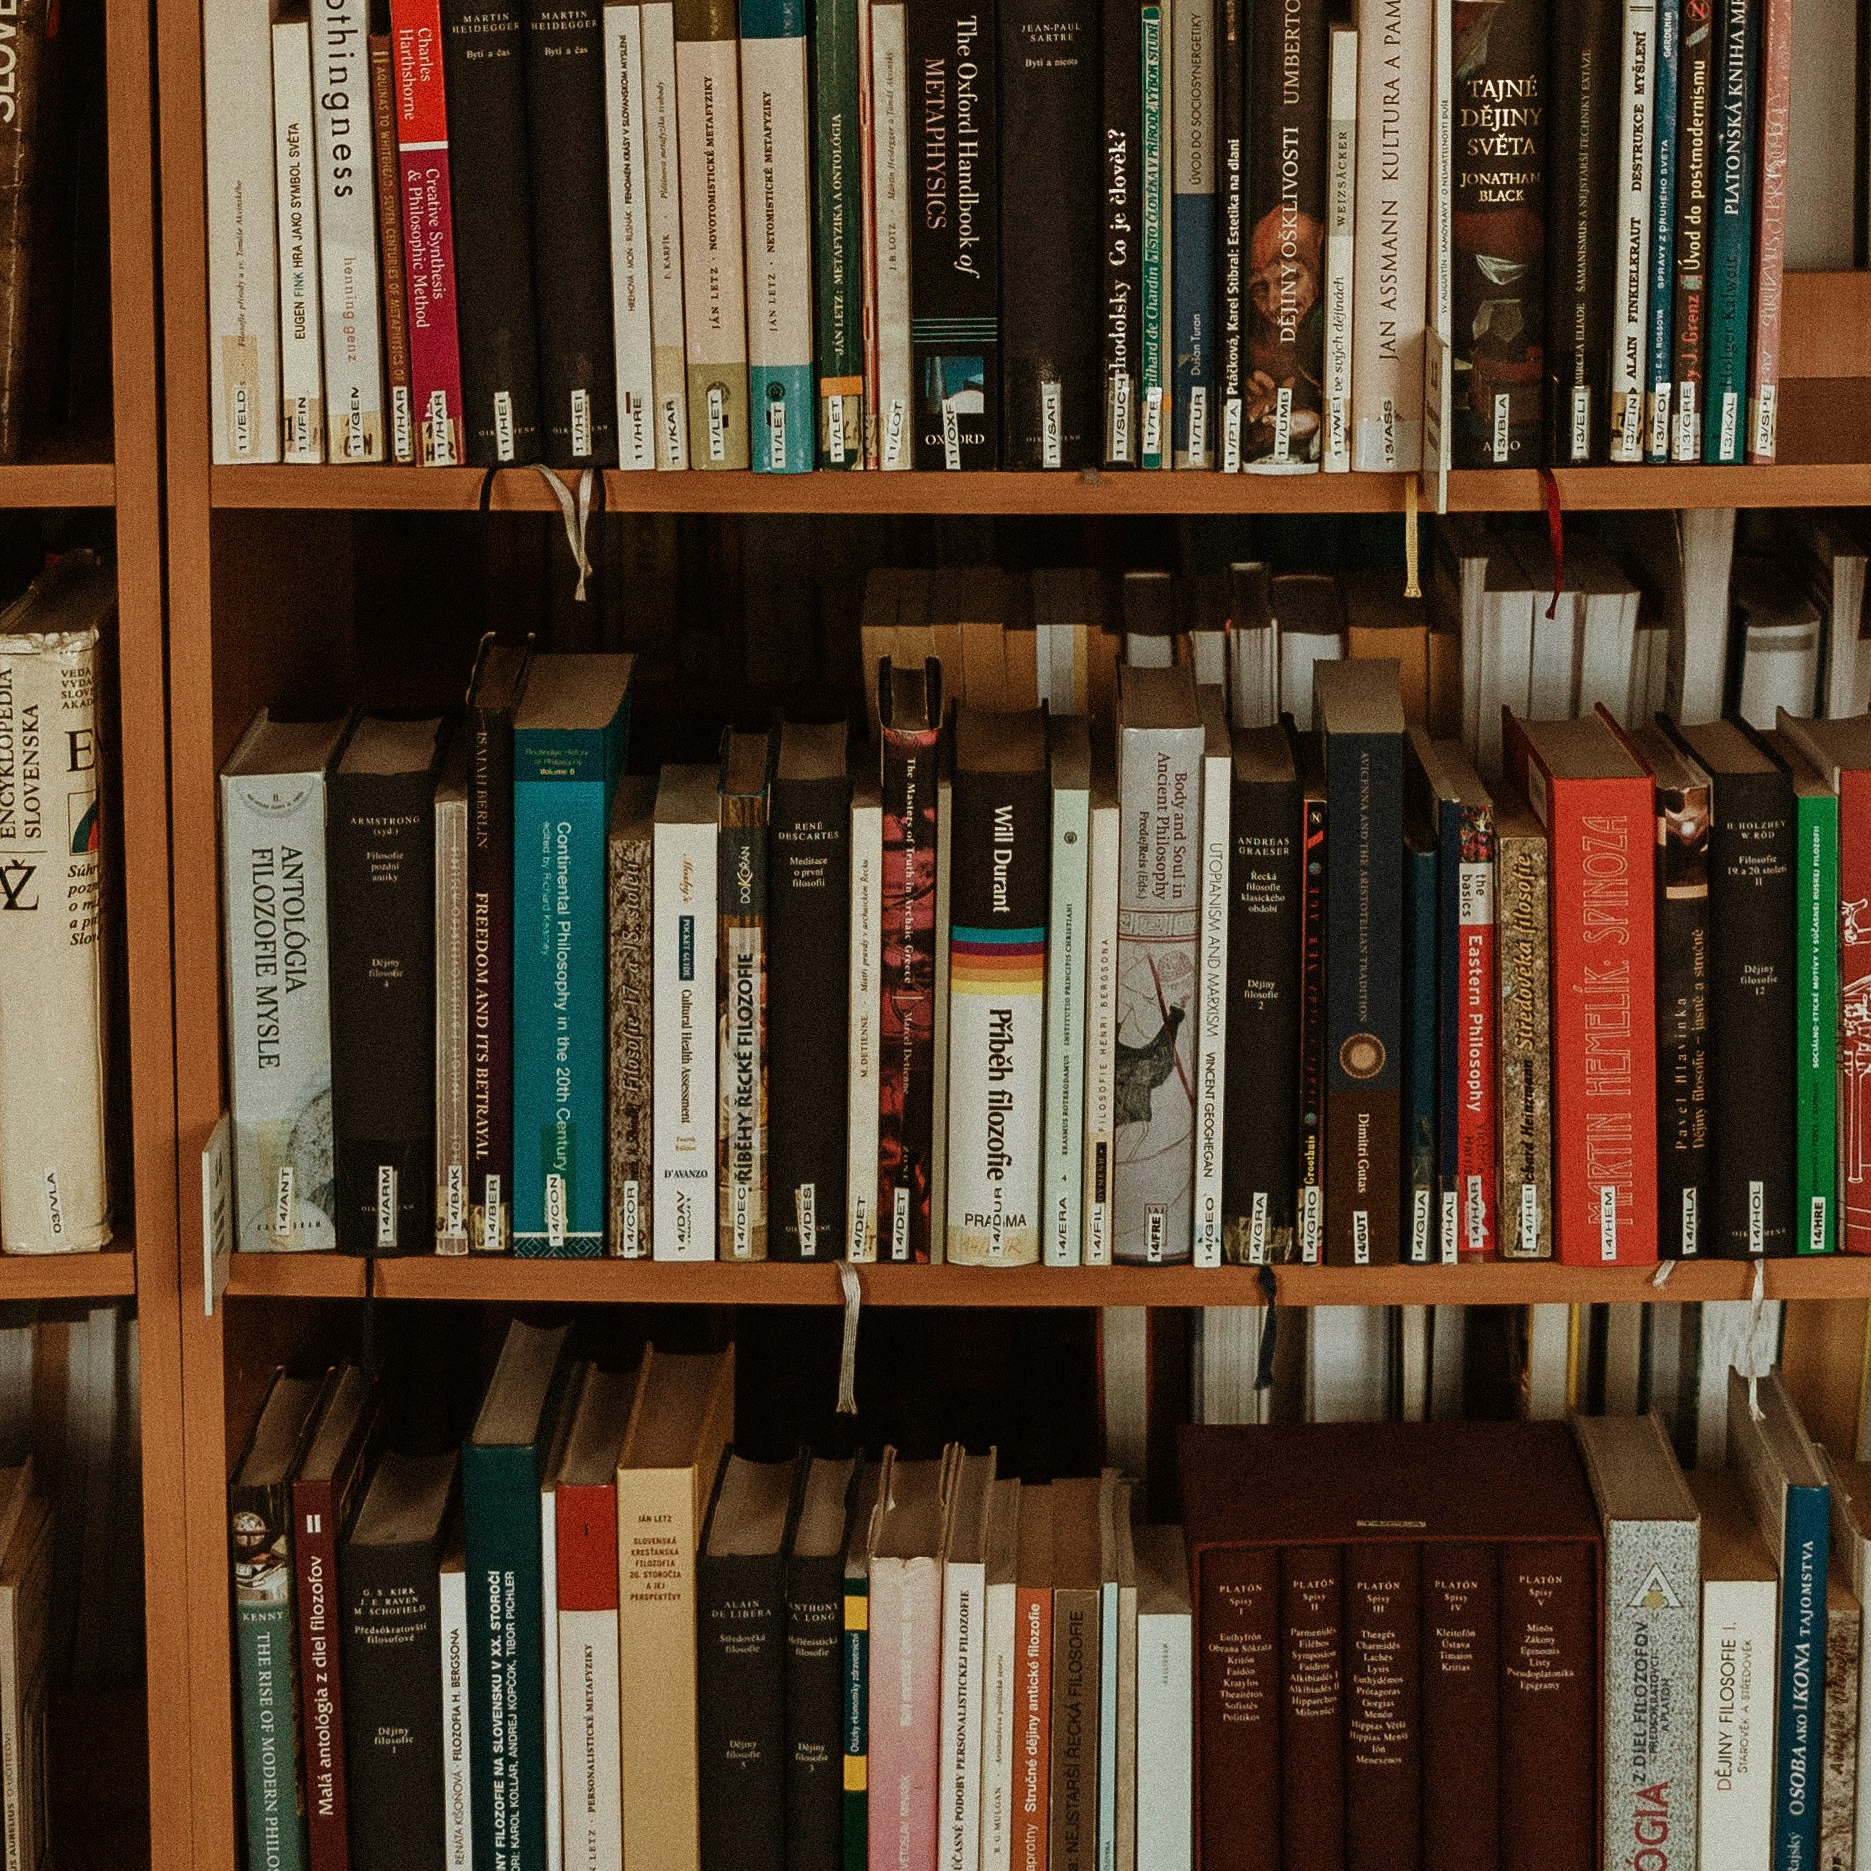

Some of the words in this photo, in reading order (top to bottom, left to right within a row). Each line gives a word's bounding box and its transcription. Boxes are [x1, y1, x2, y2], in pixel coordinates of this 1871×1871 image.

[924, 59, 945, 229] METAPHYSICS
[995, 805, 1012, 841] Will
[252, 848, 276, 976] FILOZOFIE
[993, 849, 1011, 911] Durant
[282, 846, 310, 993] ANTOLÓGIA
[1469, 935, 1482, 1004] Eastern
[256, 986, 279, 1068] MYSLE
[987, 1009, 1015, 1080] Příběh
[1468, 1014, 1482, 1111] Philosophy
[987, 1090, 1012, 1180] filozofie
[308, 1556, 324, 1630] filozofov
[311, 1636, 326, 1667] diel
[315, 1688, 332, 1767] antológia
[317, 1773, 333, 1814] Malá
